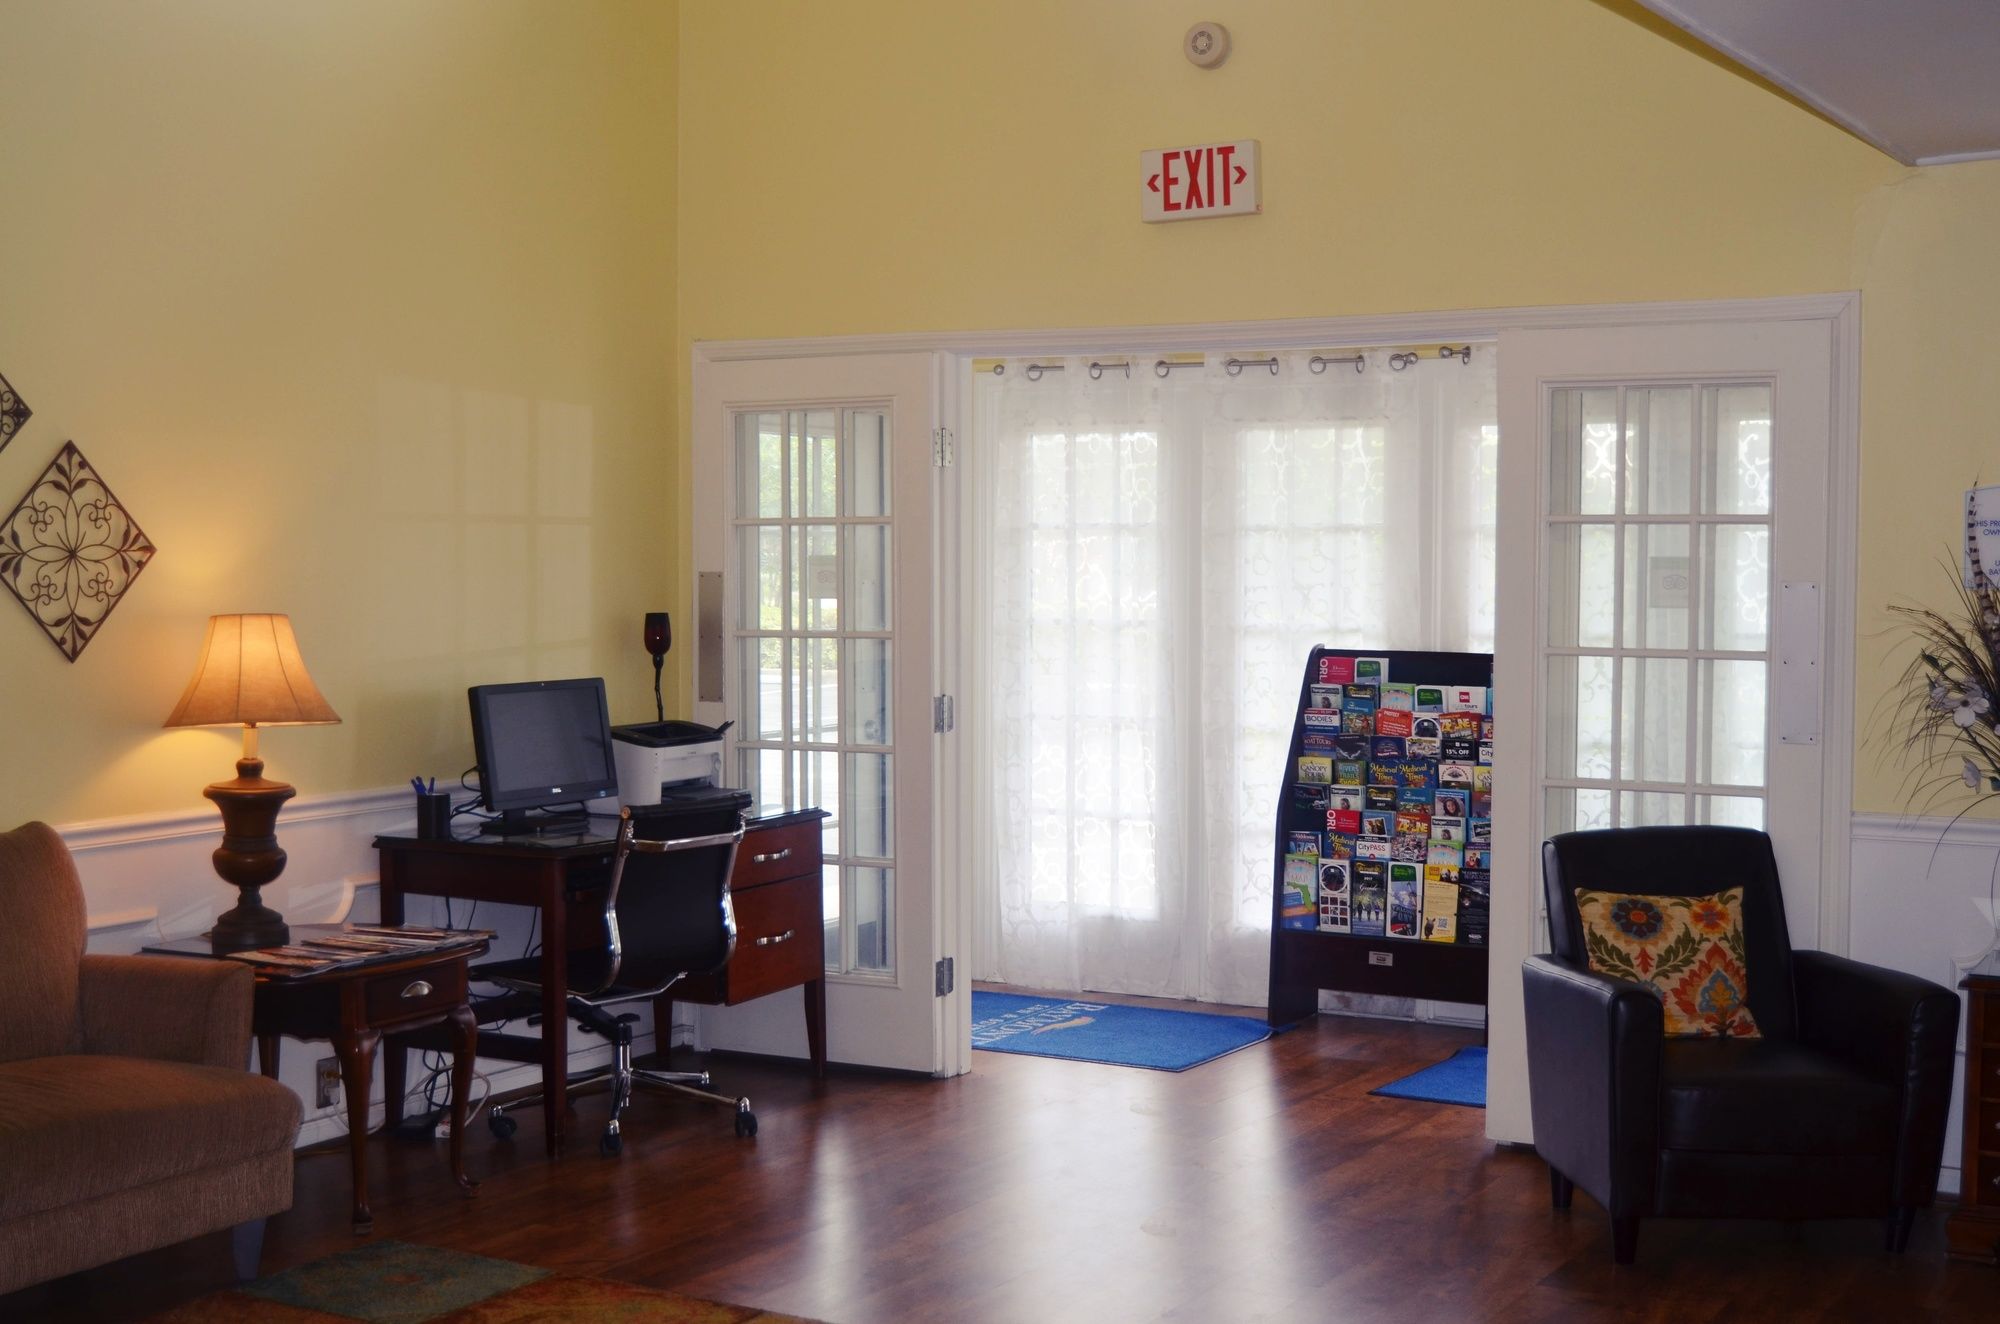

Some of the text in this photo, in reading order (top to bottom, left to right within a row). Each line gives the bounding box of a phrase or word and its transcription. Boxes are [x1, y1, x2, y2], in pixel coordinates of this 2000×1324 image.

[1162, 145, 1236, 212] EXIT
[1306, 714, 1333, 723] BODIES
[1370, 763, 1398, 775] Medieval
[1399, 763, 1427, 774] Medieval
[1326, 810, 1336, 830] ORL
[1328, 832, 1356, 846] Medieval
[1357, 843, 1386, 852] CityPASS
